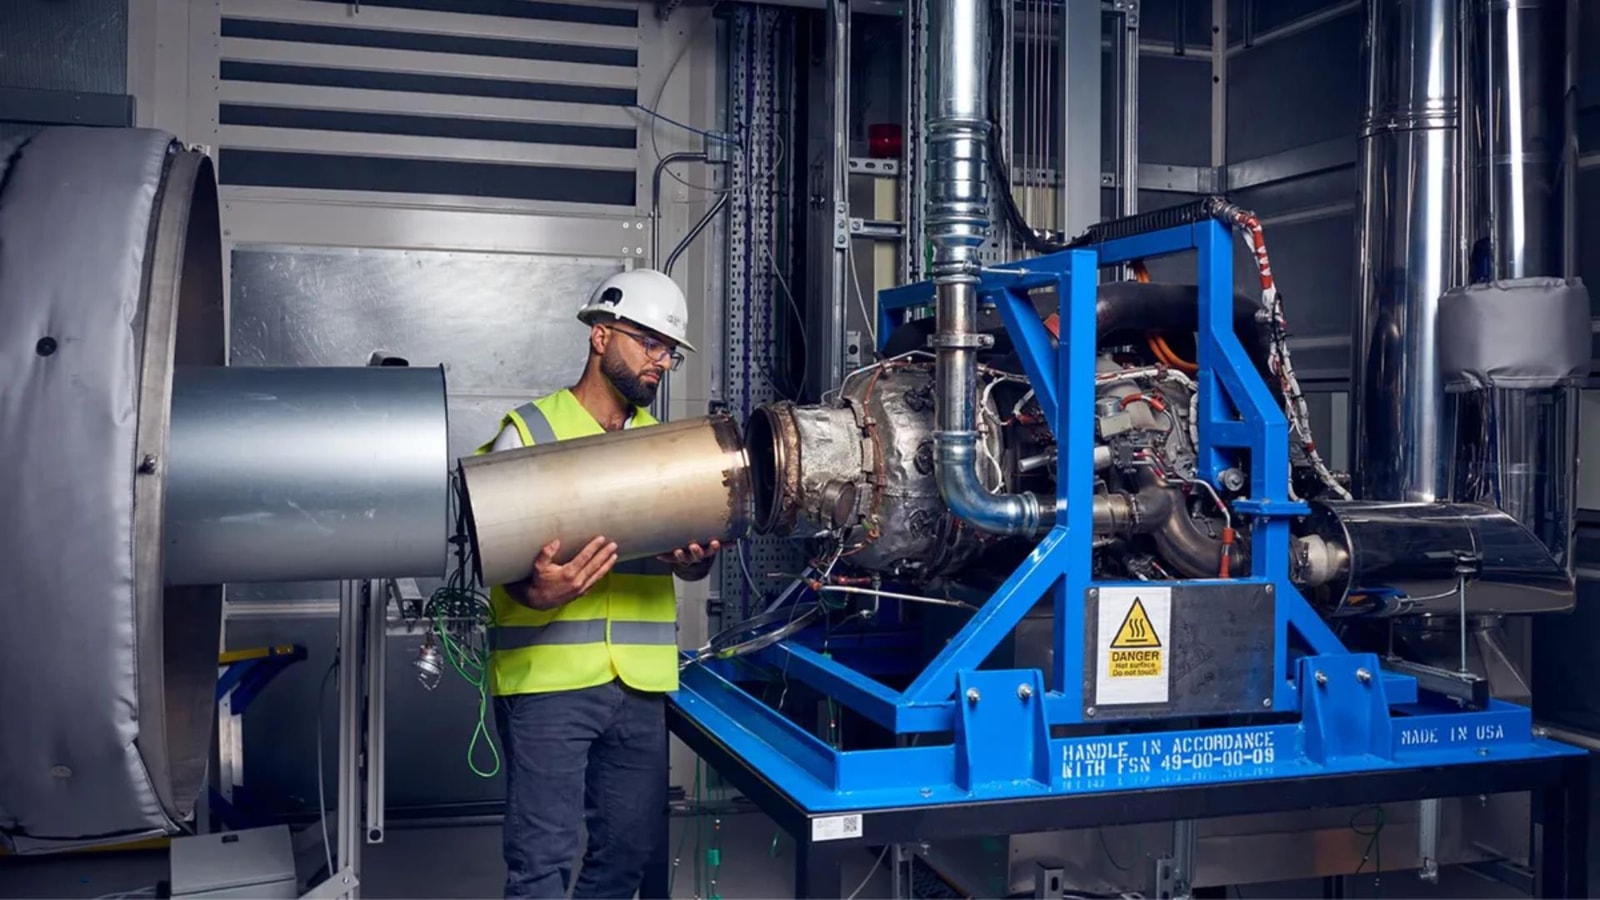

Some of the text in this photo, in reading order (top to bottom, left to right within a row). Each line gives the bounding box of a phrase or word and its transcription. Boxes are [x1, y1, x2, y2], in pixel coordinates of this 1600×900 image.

[1112, 651, 1160, 661] DANGER
[1063, 731, 1274, 761] HANDLE IN ACCORDANCE
[1401, 724, 1504, 745] MADE IN USA
[1062, 748, 1274, 779] WITH FSN 49-00-00-09
